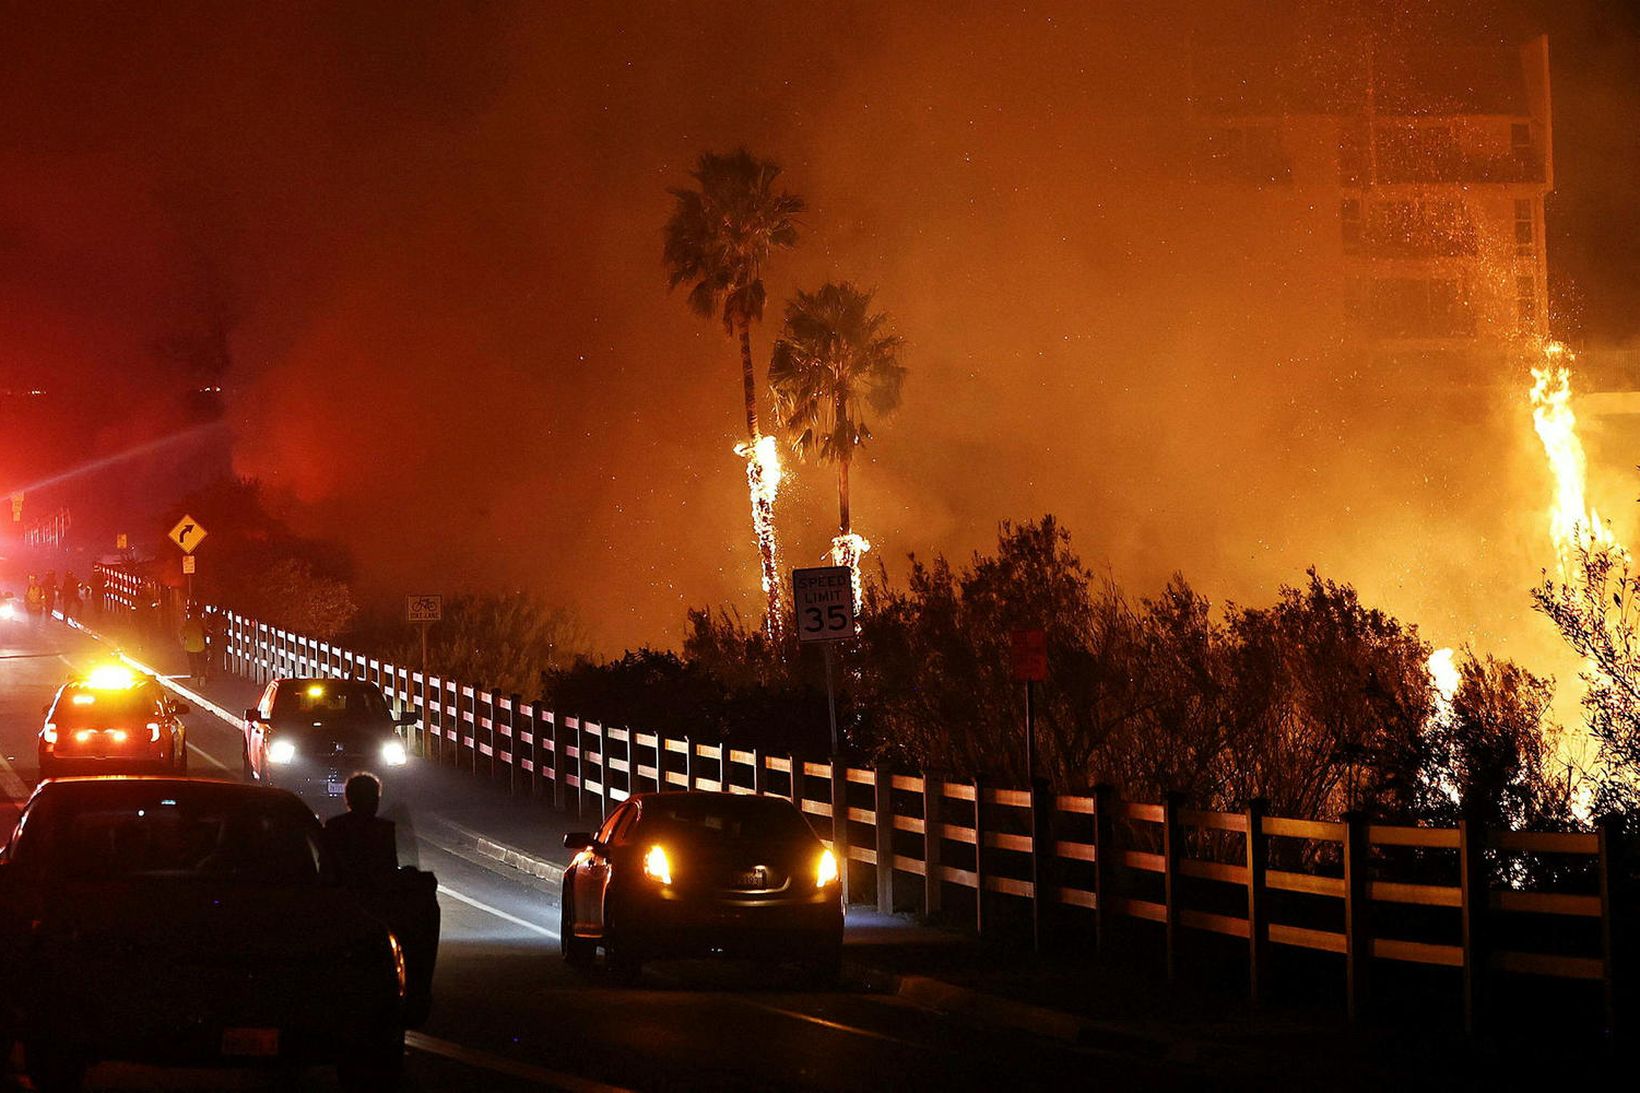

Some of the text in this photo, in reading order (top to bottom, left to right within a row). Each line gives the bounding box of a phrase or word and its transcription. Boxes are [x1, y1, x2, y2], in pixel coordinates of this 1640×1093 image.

[799, 575, 846, 588] SPEED
[805, 591, 841, 603] LIMIT
[804, 605, 848, 632] 35
